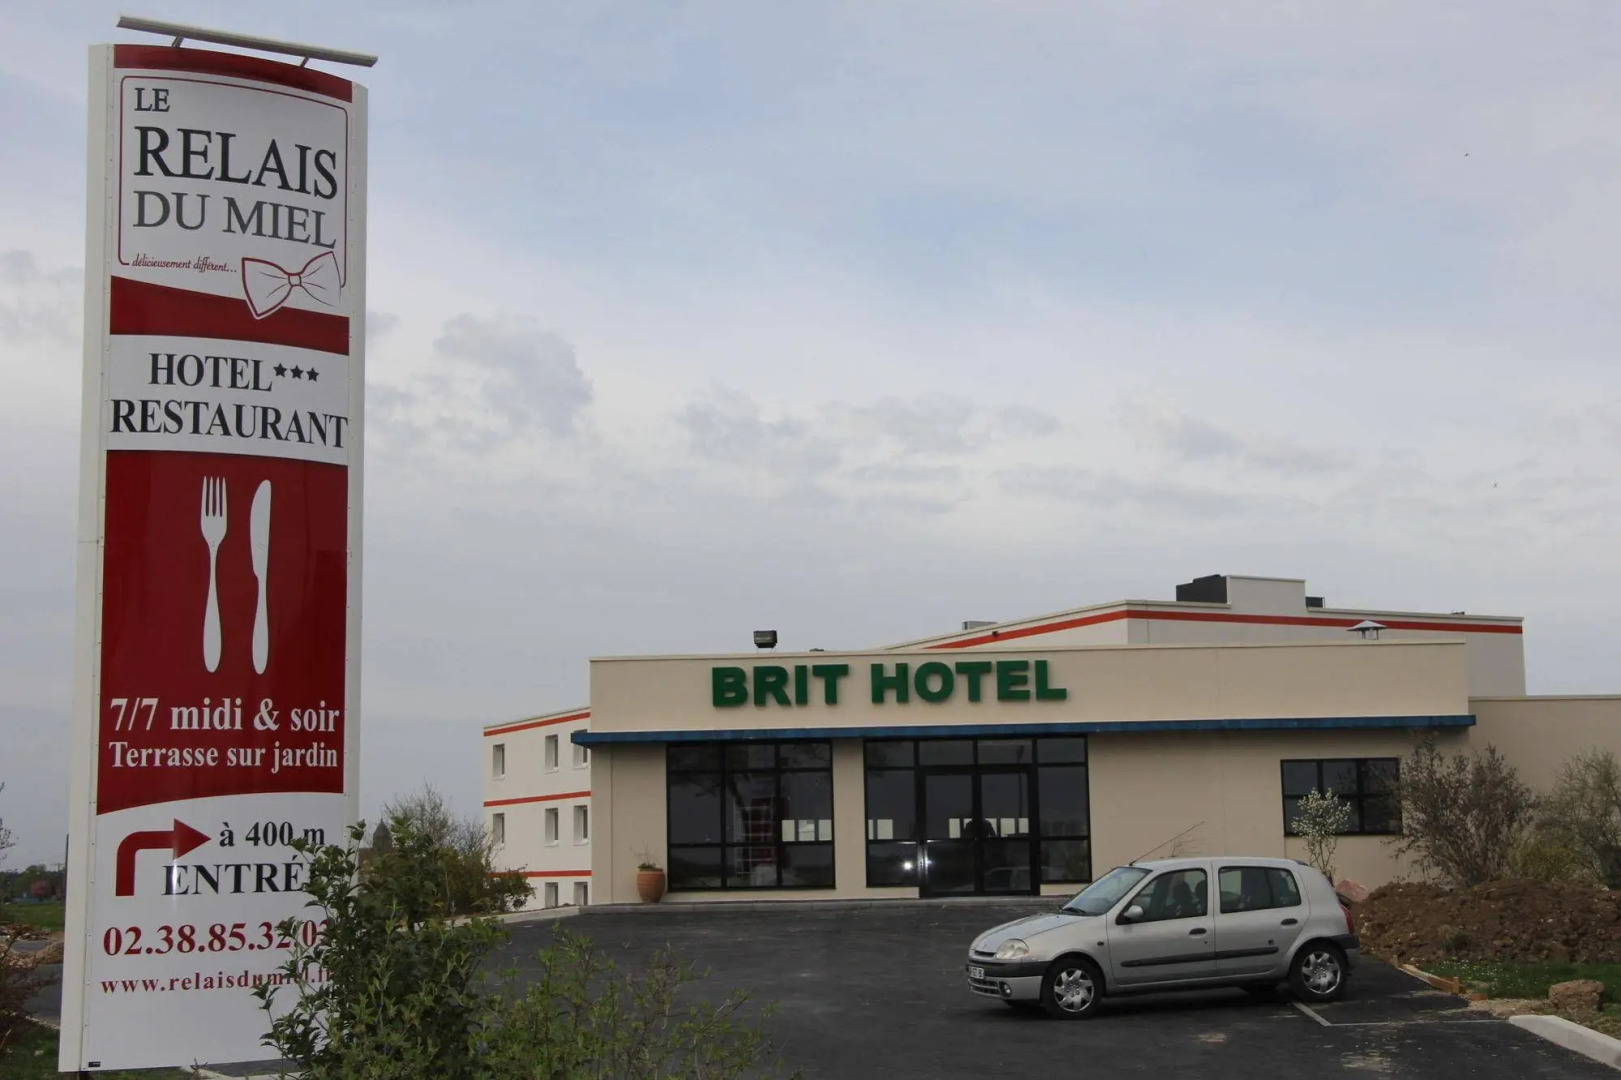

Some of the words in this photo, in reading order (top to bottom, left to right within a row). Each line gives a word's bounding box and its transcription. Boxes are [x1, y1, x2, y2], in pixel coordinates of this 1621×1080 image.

[134, 88, 170, 112] LE
[133, 126, 338, 200] RELAIS
[132, 190, 211, 230] DU
[223, 196, 336, 250] MIEL
[132, 253, 191, 269] délicieusement
[148, 353, 272, 392] HOTEL
[110, 399, 348, 448] RESTAURANT
[712, 664, 848, 707] BRIT
[871, 660, 1067, 703] HOTEL
[110, 697, 159, 731] 7/7
[170, 698, 243, 731] midi
[253, 698, 280, 732] &
[291, 700, 340, 732] soir
[108, 741, 218, 768] Terrasse
[227, 746, 266, 767] sur
[271, 741, 338, 774] jardin
[219, 822, 235, 847] à
[245, 821, 293, 847] 400
[303, 828, 325, 846] m
[161, 855, 316, 896] ENTRÉ
